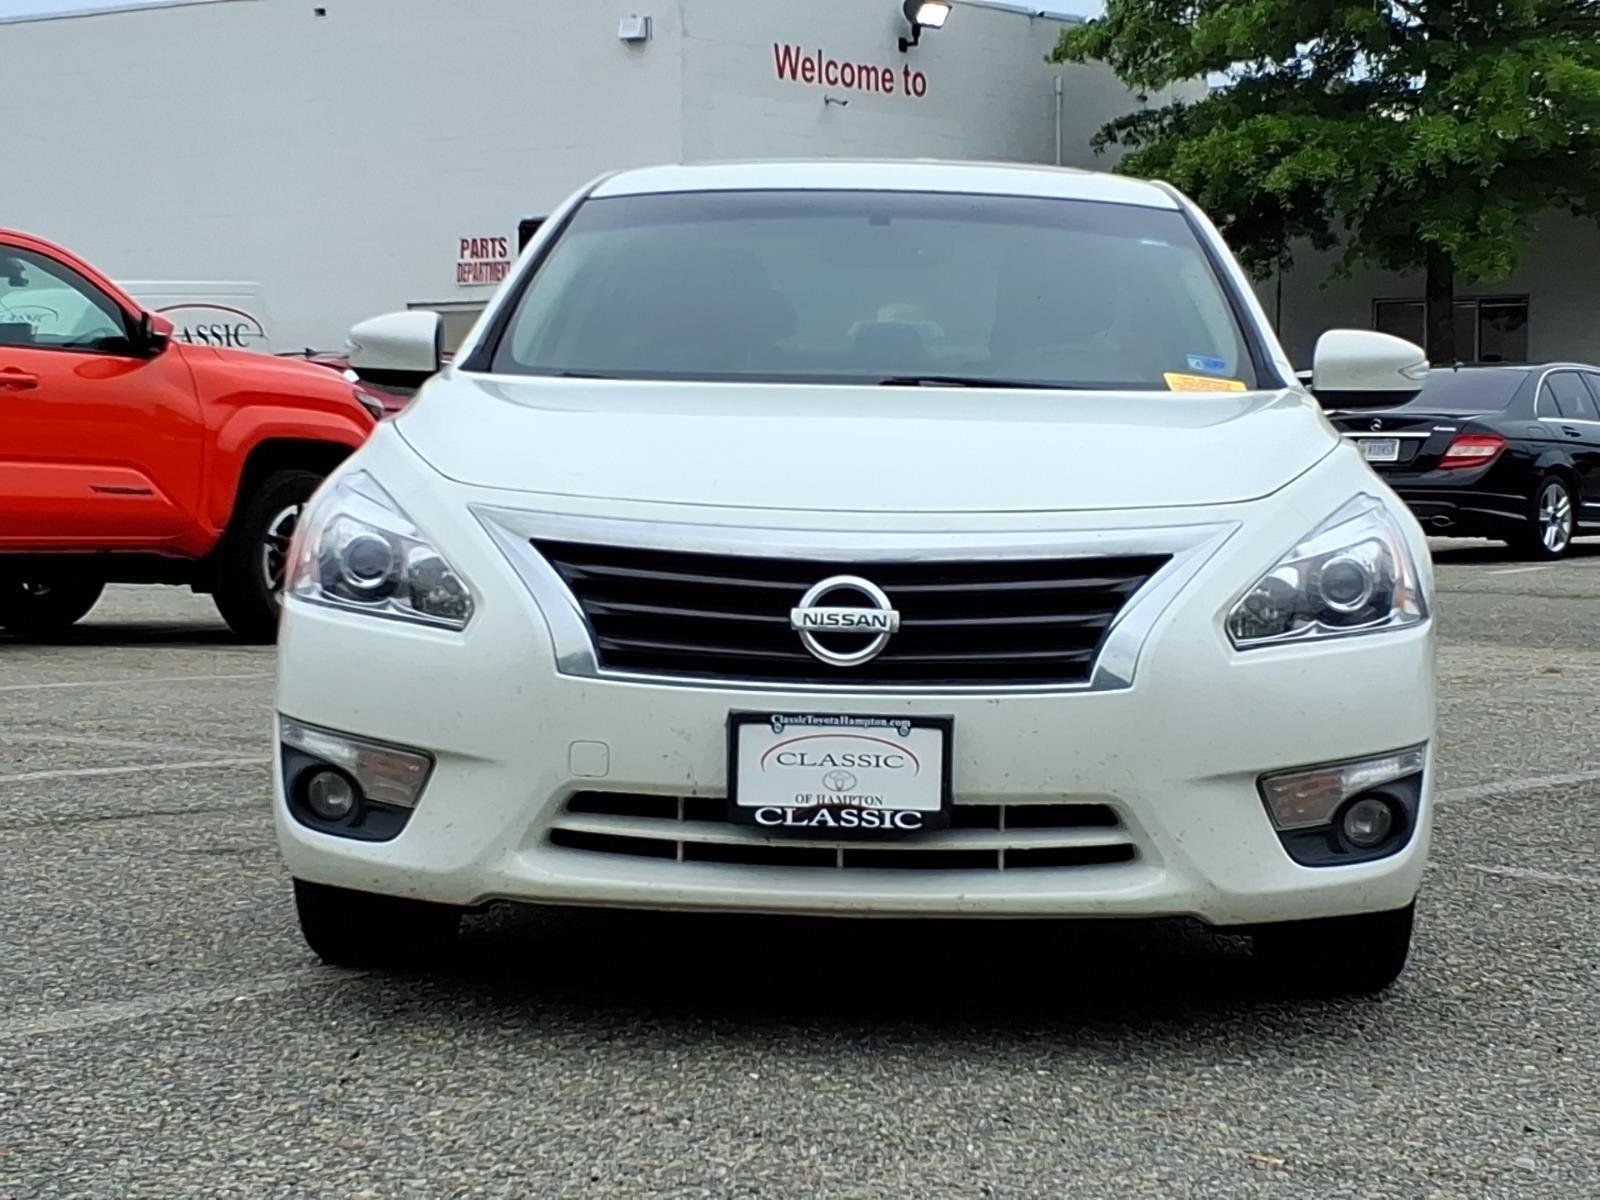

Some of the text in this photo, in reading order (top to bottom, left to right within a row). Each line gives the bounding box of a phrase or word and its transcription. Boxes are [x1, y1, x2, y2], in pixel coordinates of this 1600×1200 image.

[774, 42, 927, 97] Welcome to
[460, 237, 508, 259] PARTS
[181, 323, 250, 347] ASSIC
[802, 612, 888, 628] NISSAN
[770, 714, 912, 730] ClassicToyotaHampton.com
[776, 752, 904, 769] CLASSIC
[795, 793, 884, 807] OF HAMPTON
[754, 806, 923, 830] CLASSIC
